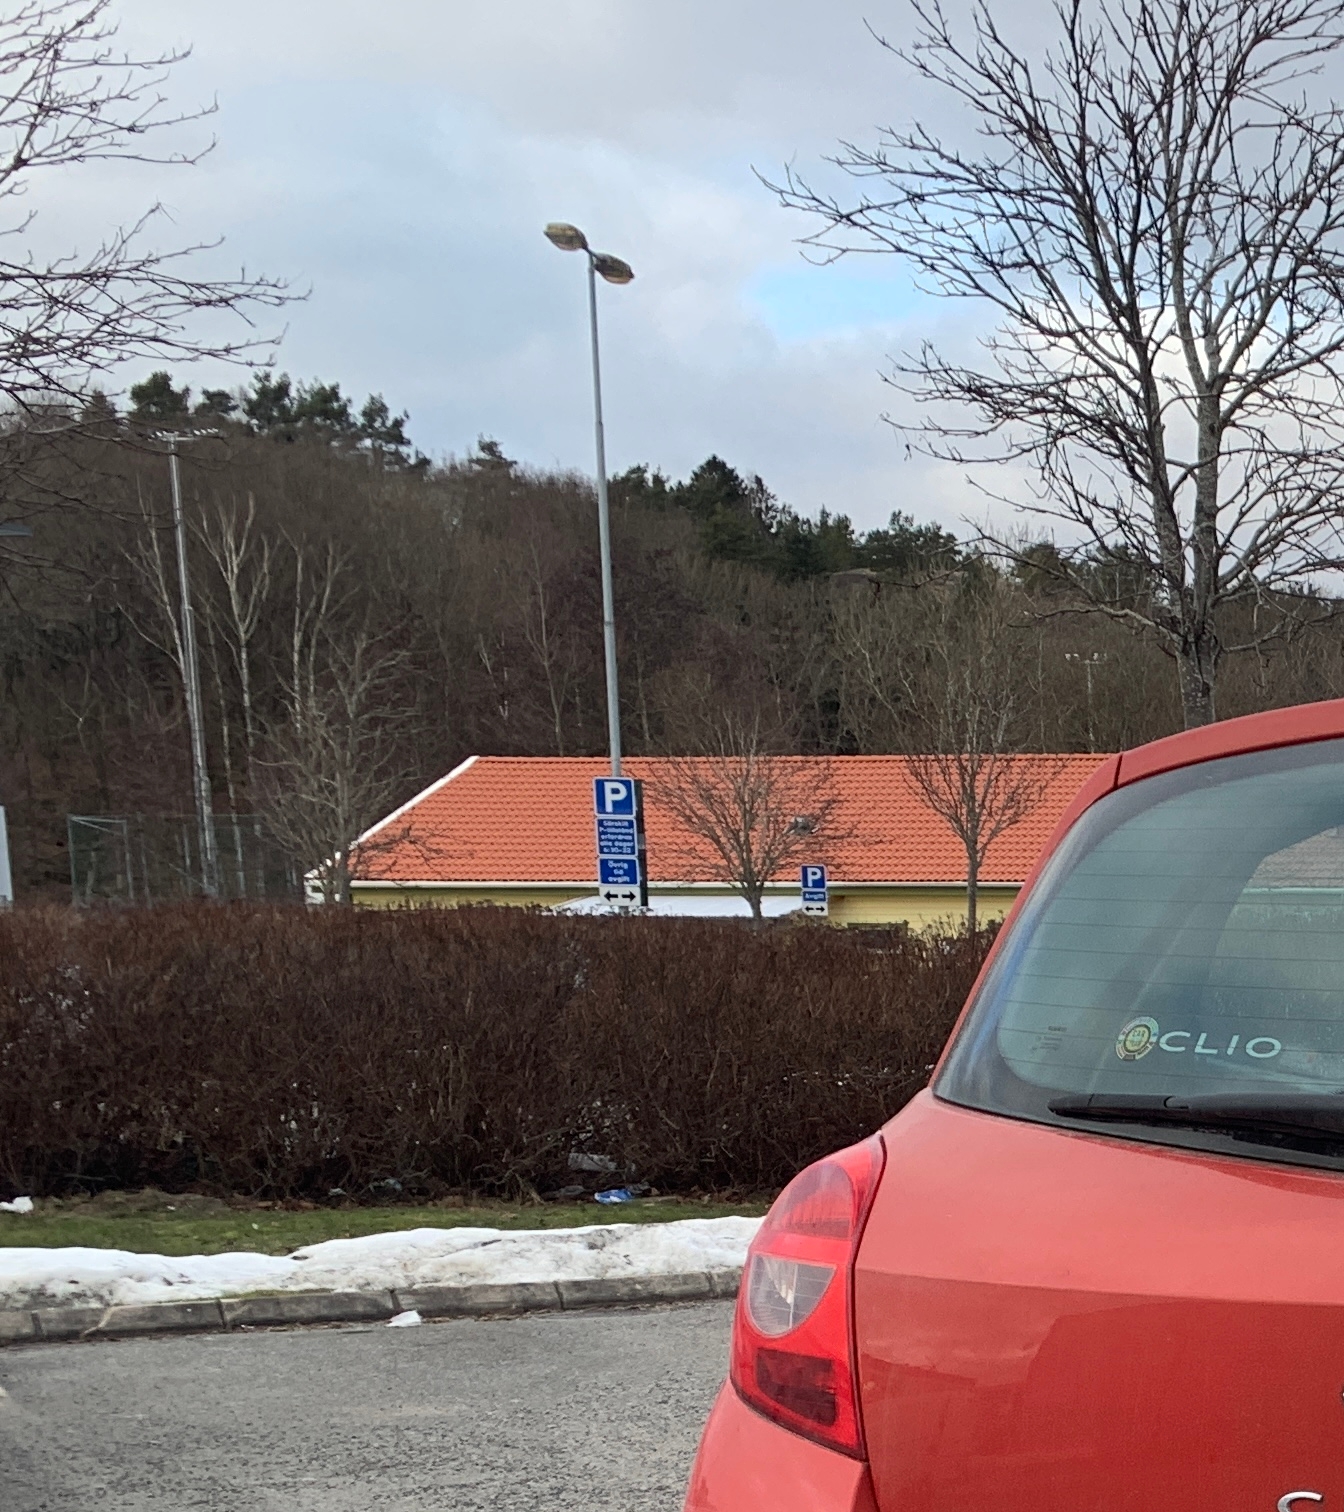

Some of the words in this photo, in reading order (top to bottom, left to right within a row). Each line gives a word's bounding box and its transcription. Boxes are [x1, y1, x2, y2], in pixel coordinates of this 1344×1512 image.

[604, 781, 627, 813] P
[608, 860, 629, 870] Övrig
[807, 867, 821, 887] P
[1158, 1030, 1282, 1059] CLIO
